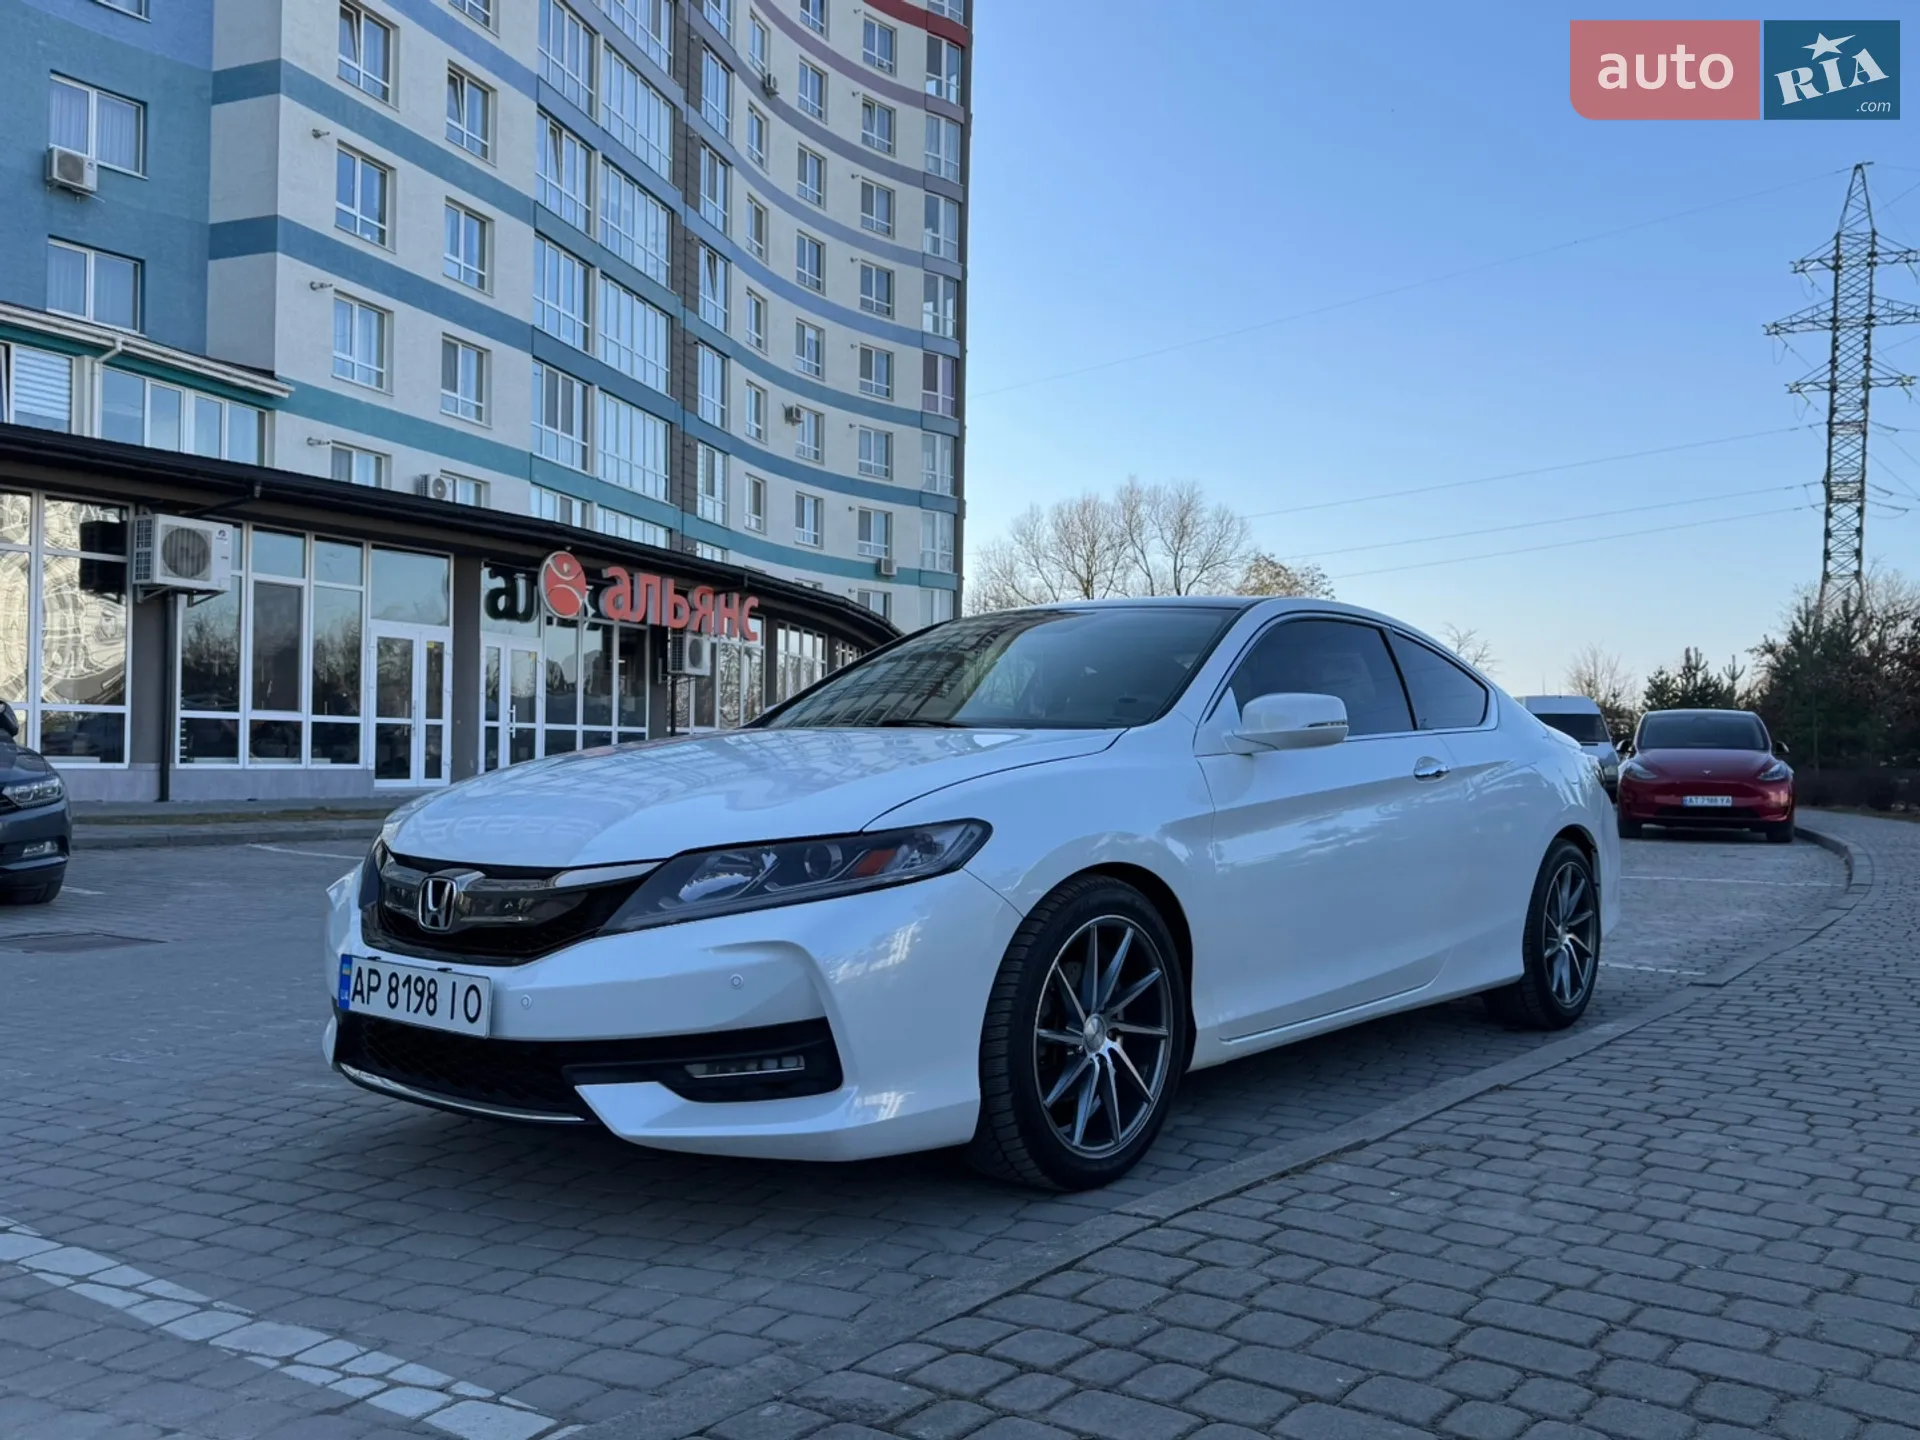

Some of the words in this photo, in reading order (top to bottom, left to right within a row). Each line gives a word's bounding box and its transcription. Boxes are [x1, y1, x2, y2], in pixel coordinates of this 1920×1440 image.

[600, 566, 759, 641] альянс
[351, 966, 381, 1005] AP
[387, 972, 438, 1017] 8198
[450, 981, 482, 1024] IO
